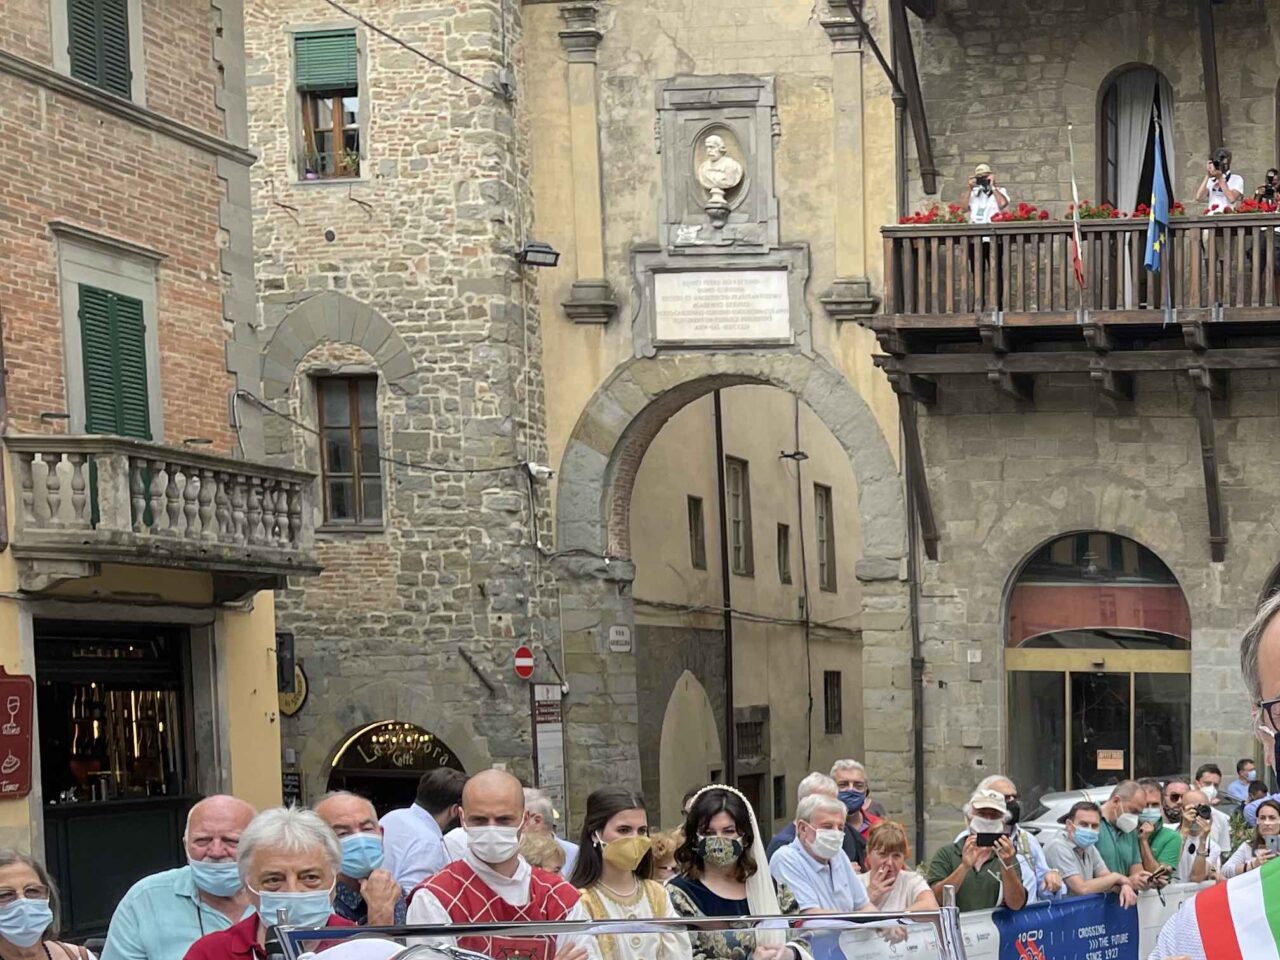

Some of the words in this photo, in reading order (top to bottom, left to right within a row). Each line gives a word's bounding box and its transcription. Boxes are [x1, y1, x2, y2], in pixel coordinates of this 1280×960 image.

[1078, 924, 1106, 939] CROSSING
[1099, 936, 1110, 948] THE
[1111, 933, 1129, 946] FUTURE
[1105, 947, 1120, 960] 1927
